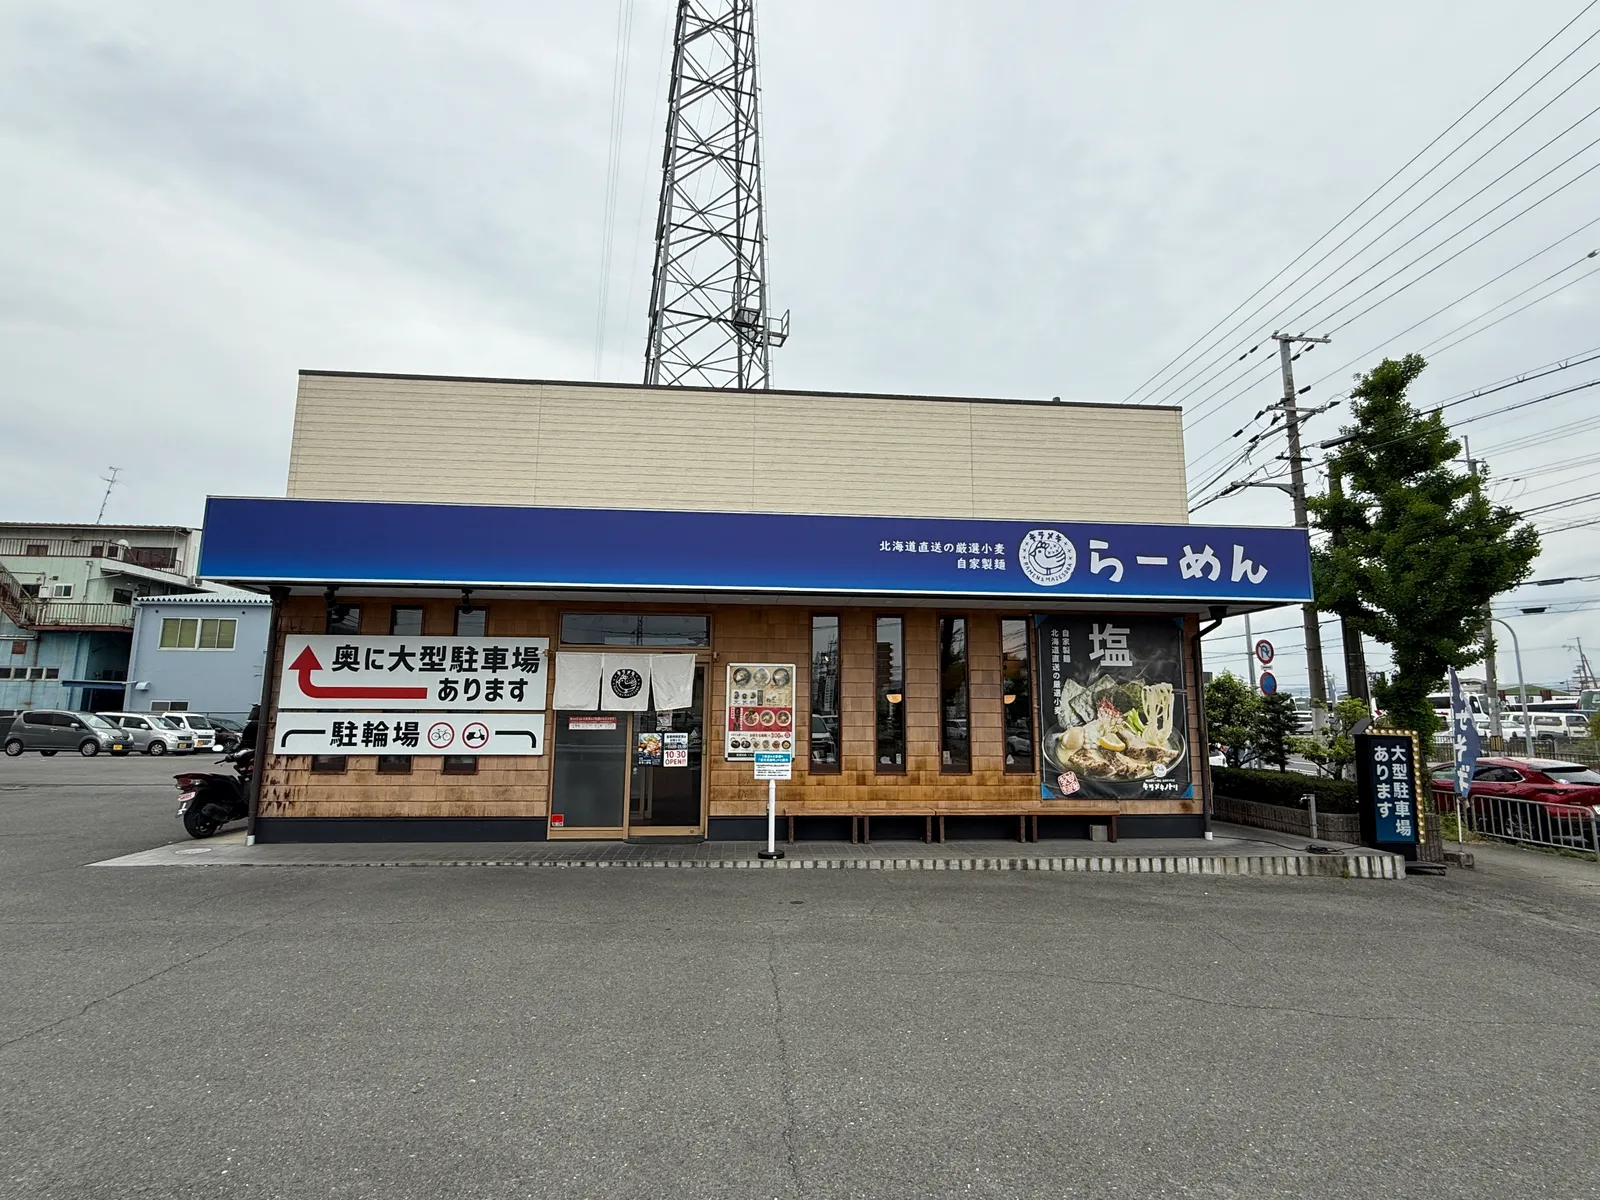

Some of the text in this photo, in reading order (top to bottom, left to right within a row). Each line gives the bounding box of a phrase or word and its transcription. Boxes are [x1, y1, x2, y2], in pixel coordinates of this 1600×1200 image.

[879, 541, 1006, 555] 北海道直送の厳選小麦
[1028, 531, 1062, 543] キラメキ
[957, 558, 1006, 571] 自家製麺
[1089, 539, 1268, 584] らーめん
[331, 644, 540, 674] 奥に大型駐車場
[1088, 623, 1133, 667] 塩
[437, 678, 529, 702] あります
[329, 720, 420, 748] 駐輪場
[1374, 745, 1393, 818] あります
[1390, 745, 1412, 836] 大型駐車場
